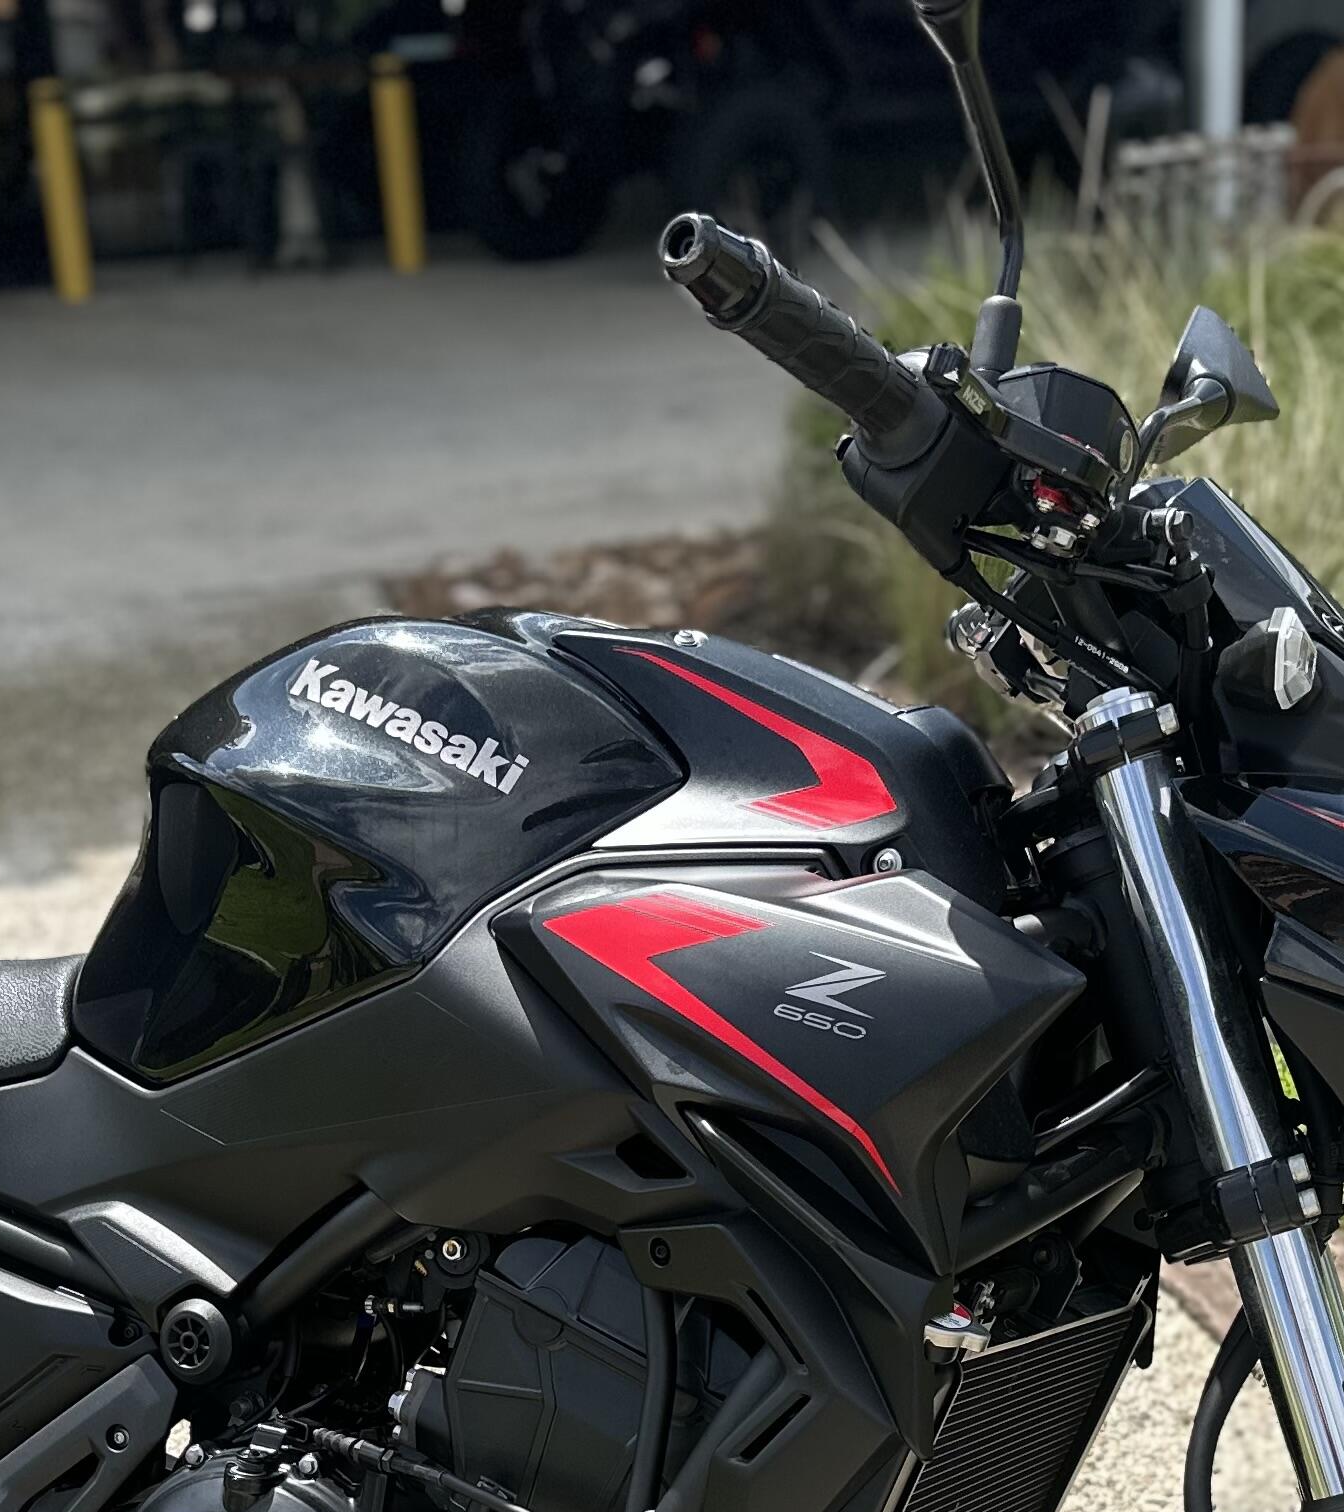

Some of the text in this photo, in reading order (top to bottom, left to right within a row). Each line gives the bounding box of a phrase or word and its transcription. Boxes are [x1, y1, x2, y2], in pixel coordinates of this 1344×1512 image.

[289, 658, 530, 795] Kawasaki
[784, 950, 888, 1020] Z
[773, 1003, 867, 1040] 650
